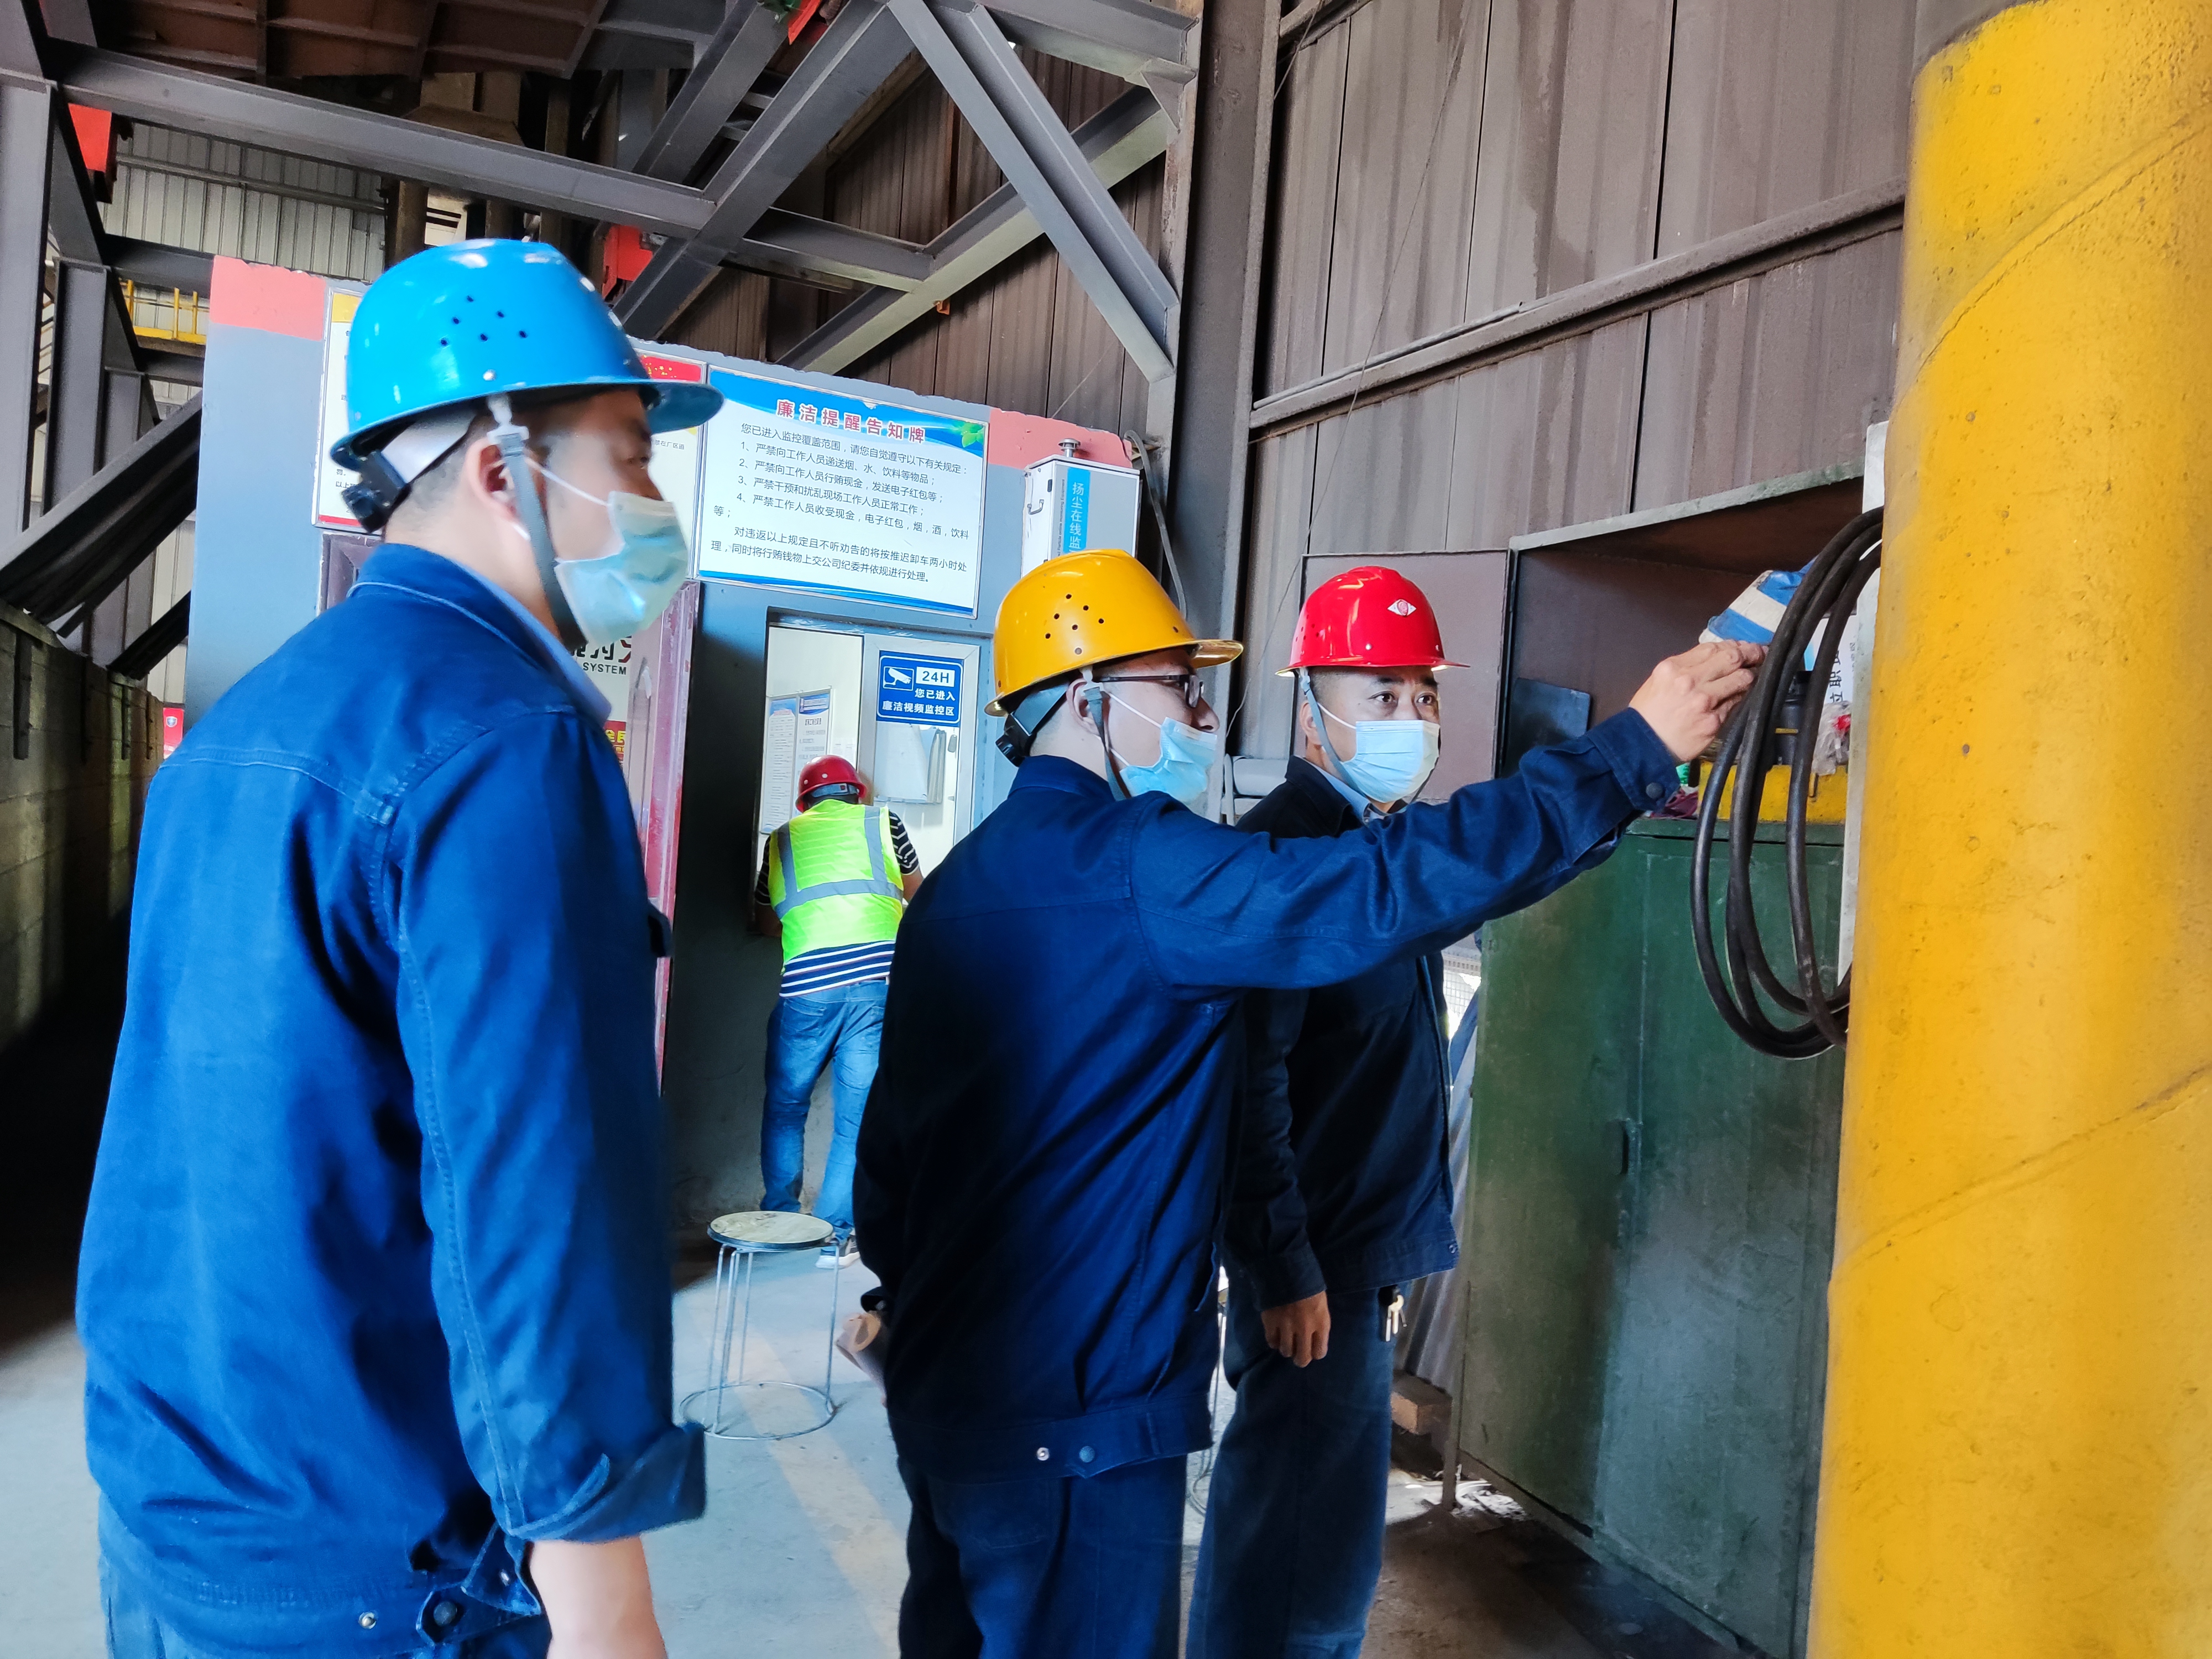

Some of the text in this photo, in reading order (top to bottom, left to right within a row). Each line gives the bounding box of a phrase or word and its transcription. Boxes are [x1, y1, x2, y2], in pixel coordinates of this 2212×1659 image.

[777, 400, 925, 444] 廉洁提醒告知牌
[1068, 482, 1085, 553] 扬尘在线监
[582, 662, 627, 675] SYSTEM
[922, 670, 950, 684] 24H
[914, 688, 956, 701] 您已进入
[881, 700, 955, 716] 廉洁视频监控区
